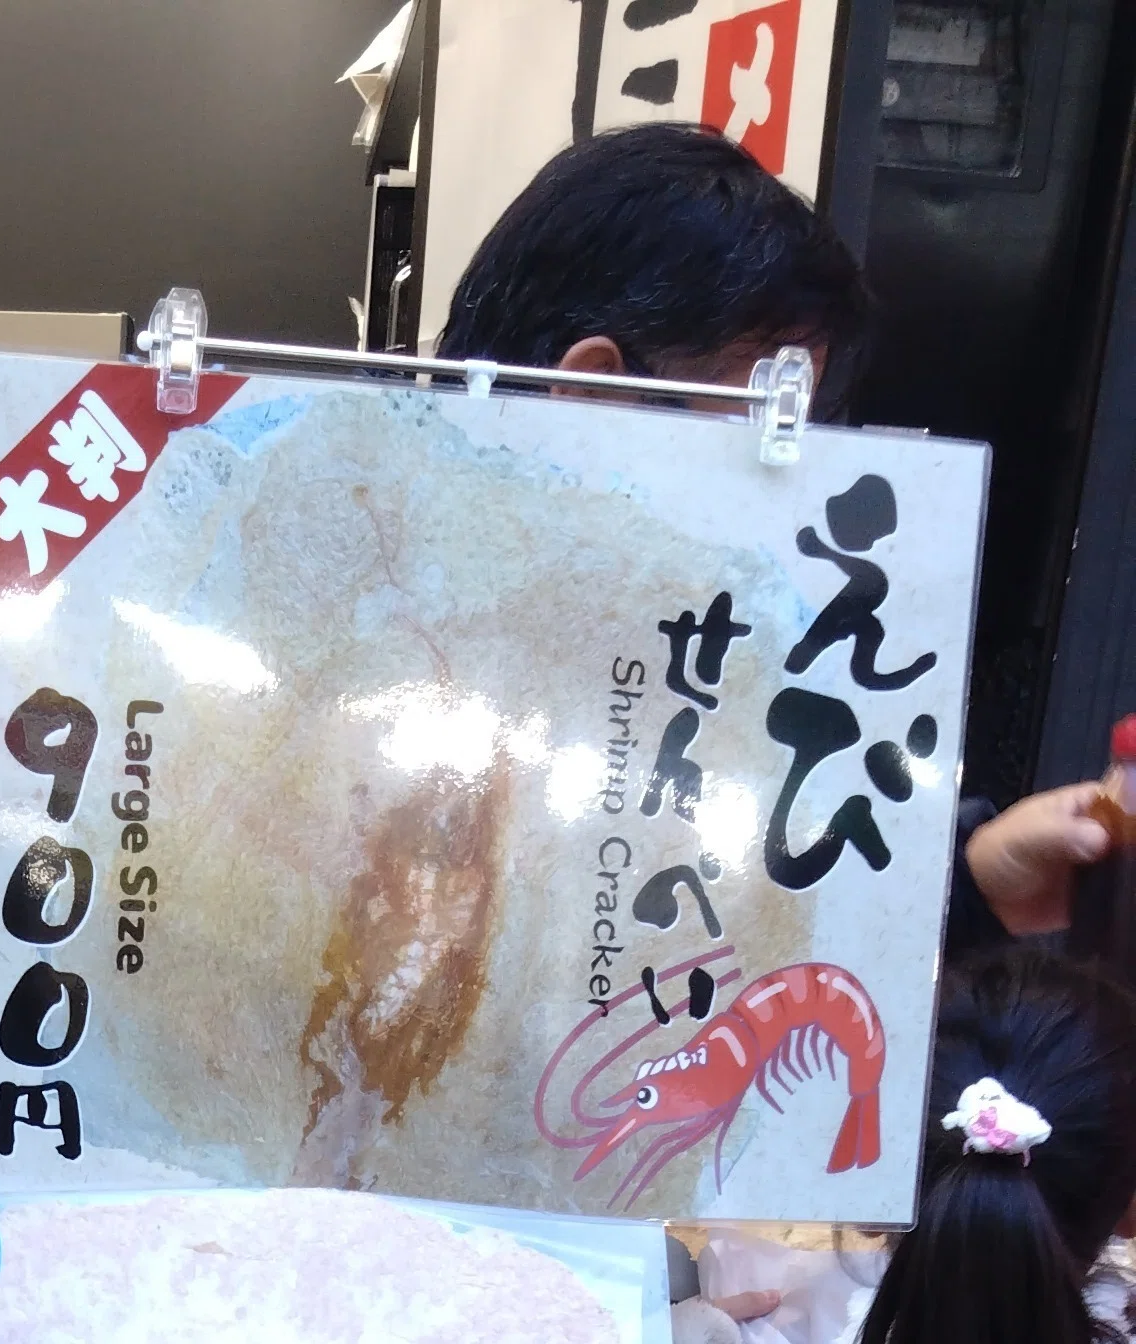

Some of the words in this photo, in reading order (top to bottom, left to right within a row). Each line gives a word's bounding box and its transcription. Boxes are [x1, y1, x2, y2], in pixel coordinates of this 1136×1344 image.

[601, 656, 646, 814] Shrimp
[764, 473, 938, 891] えび
[111, 700, 165, 854] Large
[633, 591, 752, 1026] せんべい
[116, 866, 158, 975] Size
[588, 836, 632, 1018] Cracker
